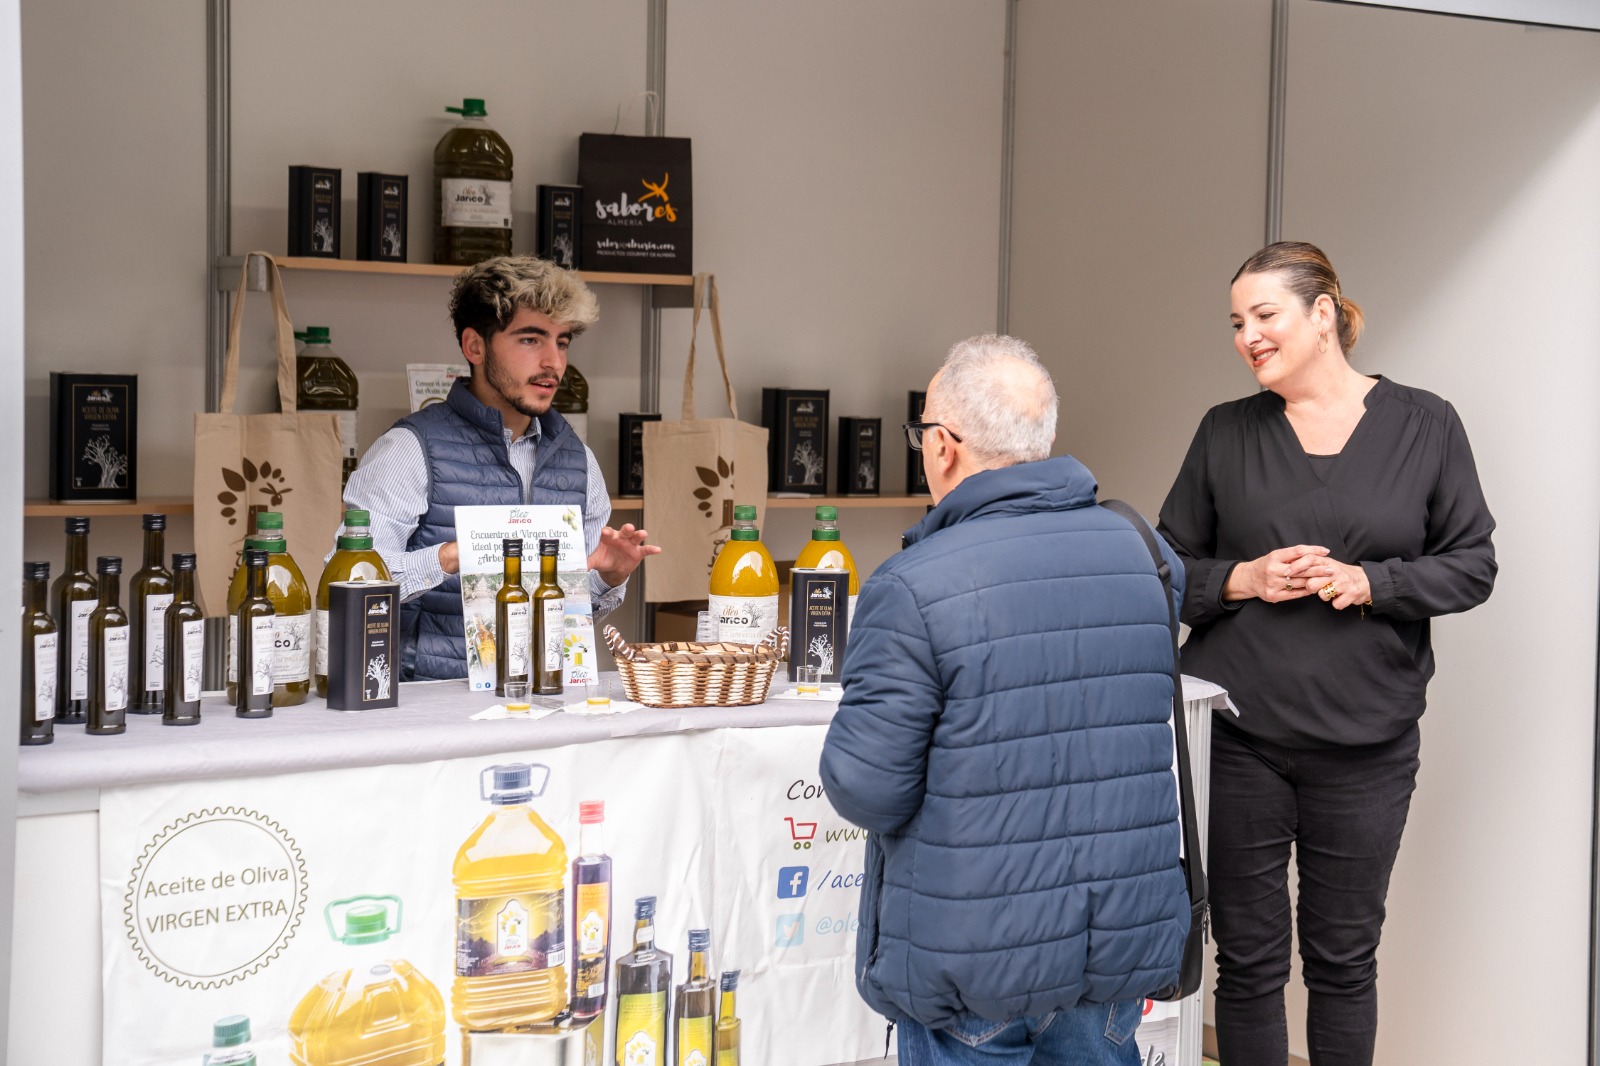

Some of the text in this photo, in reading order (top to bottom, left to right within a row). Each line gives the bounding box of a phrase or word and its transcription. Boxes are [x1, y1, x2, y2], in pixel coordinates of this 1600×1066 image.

[595, 192, 678, 222] sabores
[471, 529, 568, 541] Encuentra el Virgen Extra
[472, 542, 492, 551] ideal
[719, 615, 749, 625] arico
[144, 866, 289, 899] Aceite de Oliva
[146, 899, 288, 933] VIRGEN EXTRA
